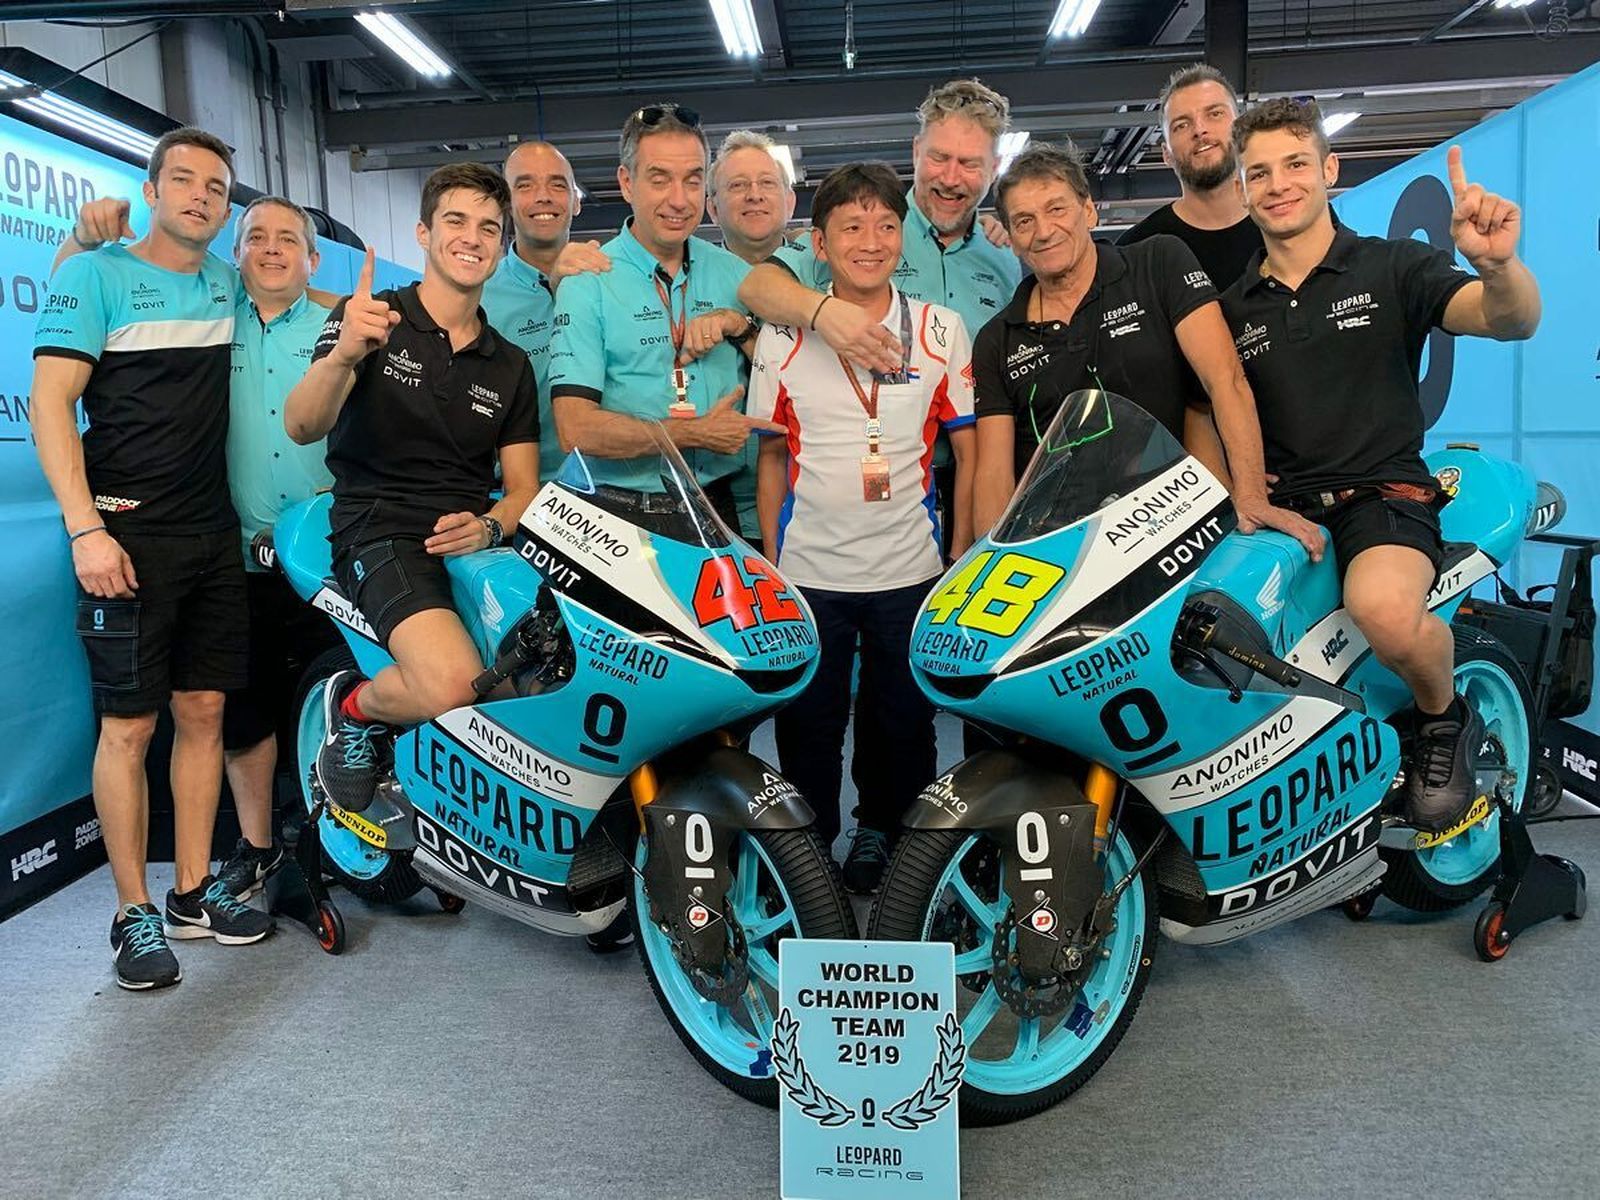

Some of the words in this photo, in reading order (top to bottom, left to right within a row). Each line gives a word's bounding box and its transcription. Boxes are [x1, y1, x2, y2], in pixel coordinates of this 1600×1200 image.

[0, 152, 95, 220] OPARD
[1, 213, 70, 246] NATURA
[45, 294, 78, 310] PARD
[133, 301, 167, 310] DOVIT
[1103, 302, 1139, 321] LEOPARD
[1331, 293, 1371, 312] LEOPARD
[640, 335, 670, 346] DOVIT
[383, 366, 421, 387] DOVIT
[1010, 354, 1050, 380] DOVIT
[96, 495, 141, 506] PADDOCK
[1105, 468, 1200, 547] ANONIMO
[541, 494, 630, 560] ANONIMO
[1145, 501, 1193, 537] WATCHES
[550, 523, 592, 554] WATCHES
[1157, 517, 1224, 577] DOVIT
[520, 540, 581, 589] DOVIT
[691, 554, 805, 632] 42
[926, 550, 1066, 637] 48
[578, 624, 670, 680] LEOPARD
[740, 624, 818, 656] LEOPARD
[916, 631, 988, 662] LEOPARD
[1320, 629, 1350, 666] HRC
[588, 659, 640, 686] NATURAL
[768, 651, 807, 668] NATURAL
[922, 660, 961, 675] NATURAL
[1048, 631, 1150, 698] LEOPARD
[1228, 646, 1265, 669] domino
[1082, 668, 1138, 701] NATURAL
[468, 717, 572, 787] ANONIMO
[1170, 713, 1294, 791] ANONIMO
[1562, 747, 1598, 782] HRC
[490, 752, 542, 788] WATCHES
[1209, 755, 1270, 793] WATCHES
[414, 726, 583, 856] LEOPARD
[923, 783, 968, 813] ONIMO
[1193, 718, 1383, 862] LEOPARD
[75, 818, 99, 838] PADD
[339, 810, 385, 842] DUNLOP
[435, 800, 524, 869] NATURAL
[1249, 803, 1353, 878] NATURAL
[10, 839, 59, 882] HRC
[417, 816, 549, 907] DOVIT
[1219, 816, 1374, 916] DOVIT
[821, 962, 914, 983] WORLD
[798, 989, 939, 1011] CHAMPION
[831, 1017, 905, 1037] TEAM
[838, 1042, 900, 1066] 2019
[836, 1146, 902, 1167] LEOPARD
